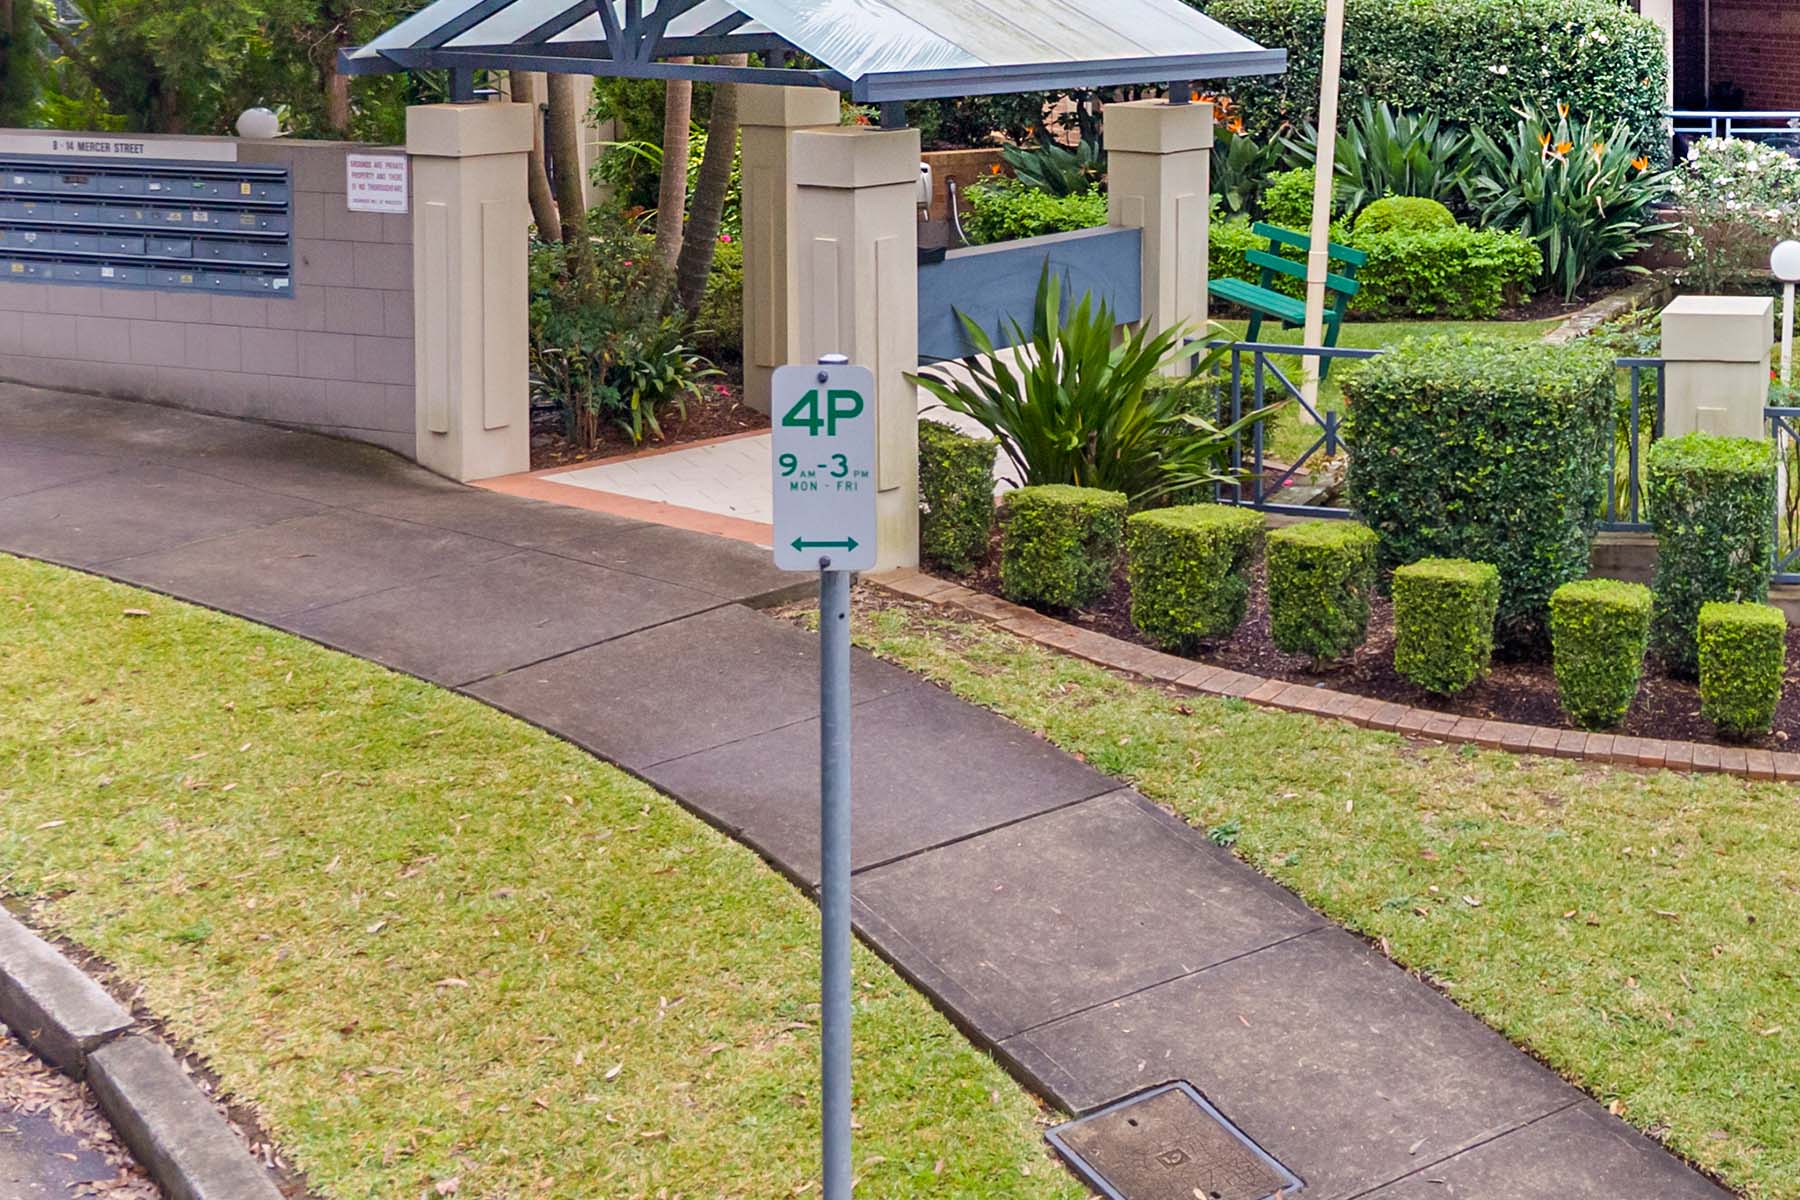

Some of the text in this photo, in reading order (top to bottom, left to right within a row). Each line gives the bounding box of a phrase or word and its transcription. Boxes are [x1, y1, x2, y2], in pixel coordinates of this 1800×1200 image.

[77, 141, 111, 153] MERCER
[113, 142, 144, 154] STREET
[781, 389, 864, 436] 4P
[790, 481, 818, 491] MON
[836, 481, 858, 491] FRI
